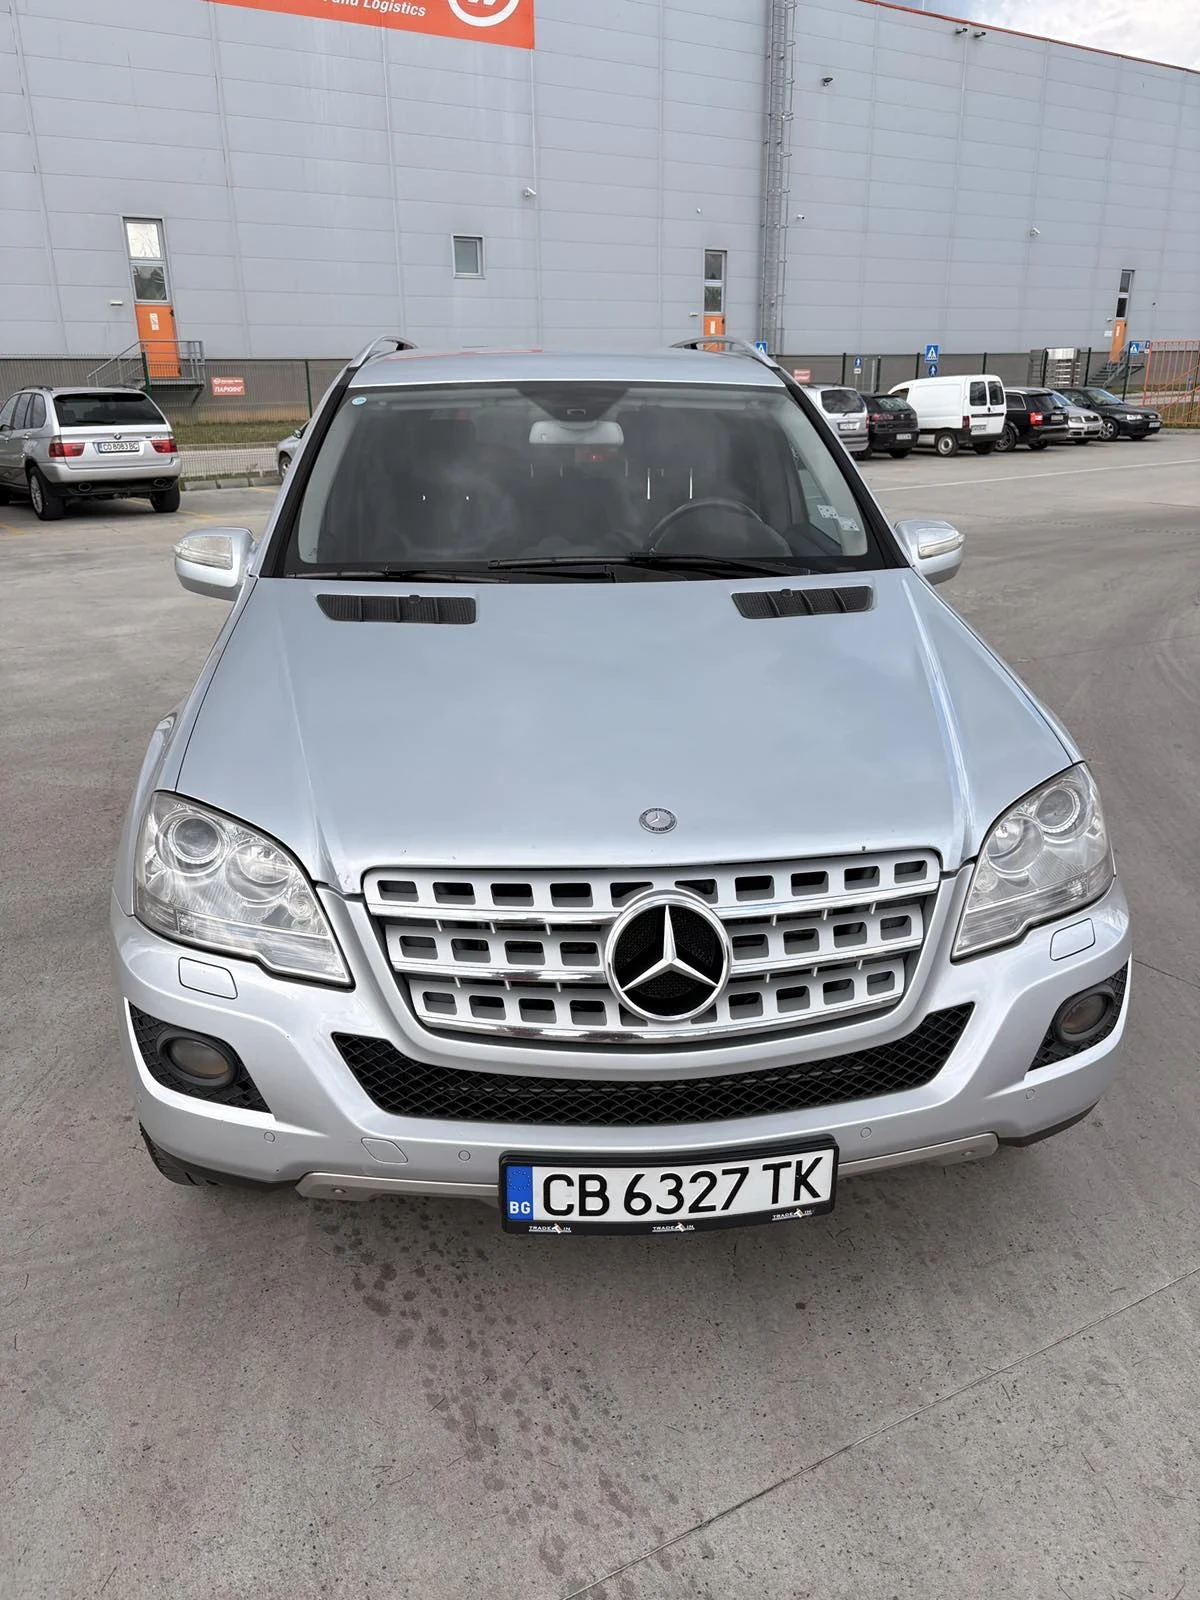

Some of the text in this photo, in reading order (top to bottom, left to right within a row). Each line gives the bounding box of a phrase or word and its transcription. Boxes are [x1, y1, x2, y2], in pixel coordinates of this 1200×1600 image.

[363, 0, 426, 17] Logistics
[543, 1156, 824, 1217] CB 6327 TK
[509, 1201, 531, 1215] BG
